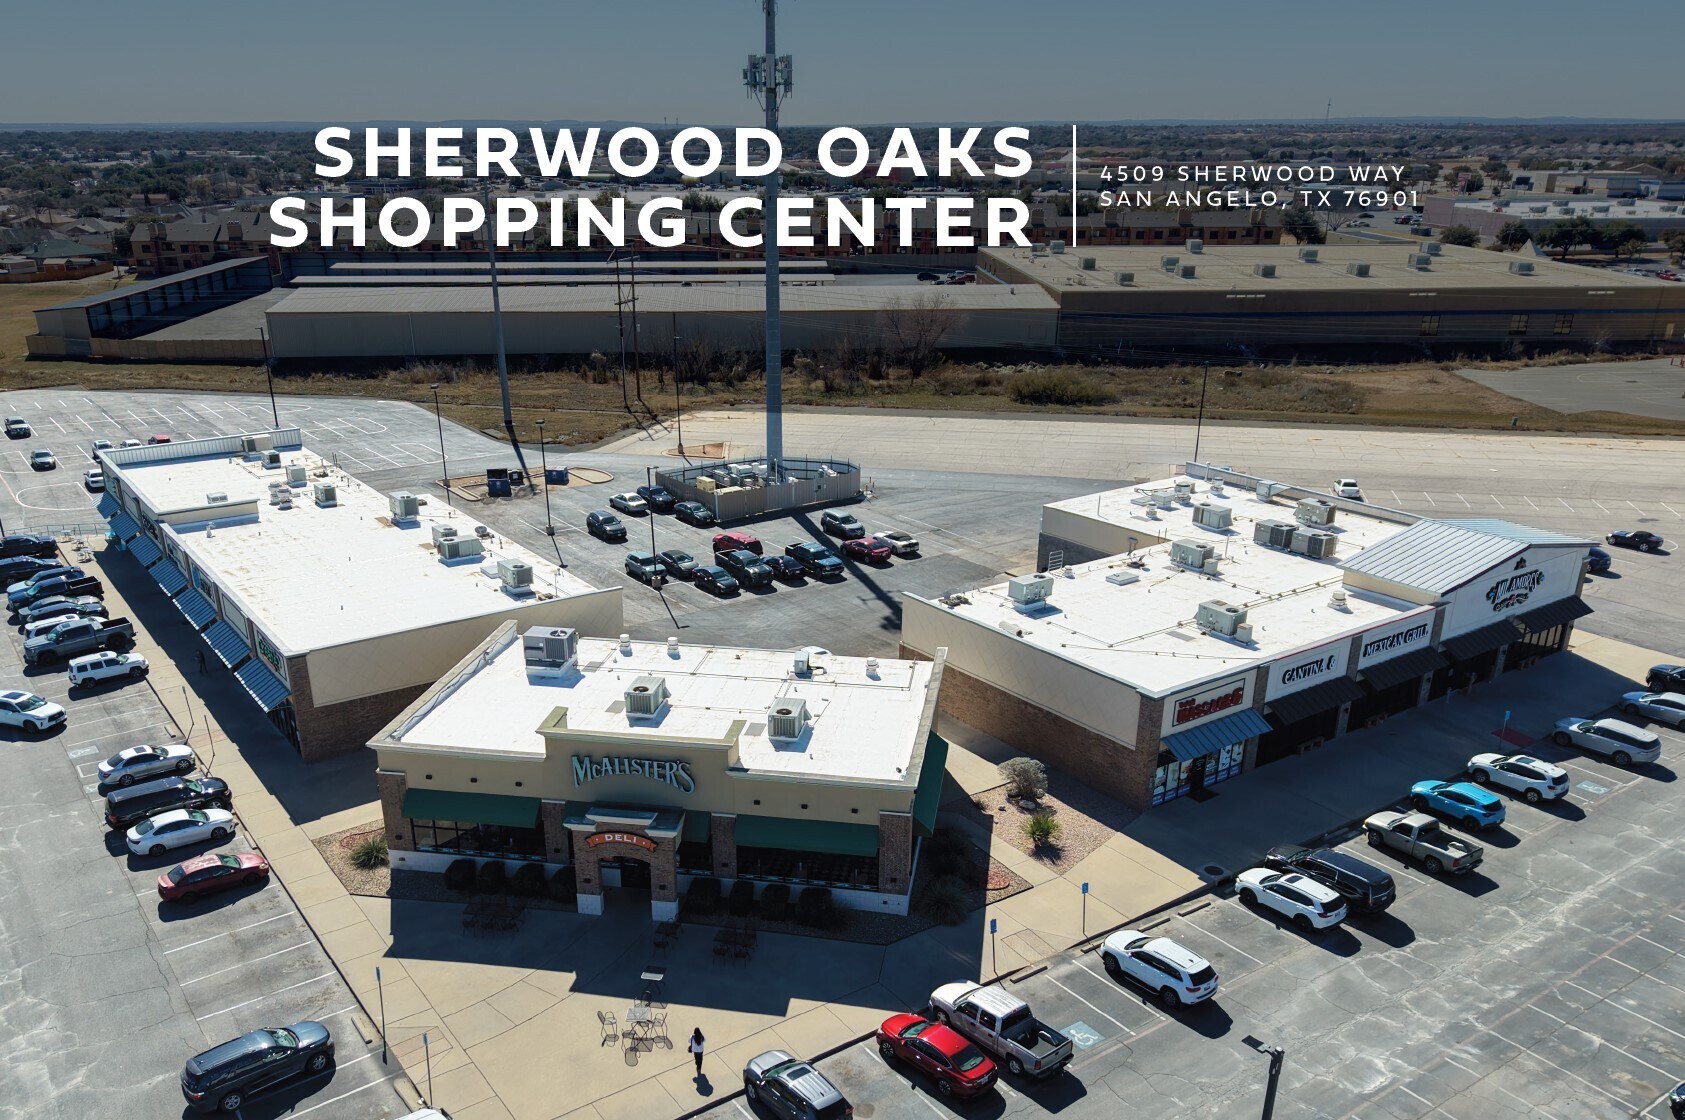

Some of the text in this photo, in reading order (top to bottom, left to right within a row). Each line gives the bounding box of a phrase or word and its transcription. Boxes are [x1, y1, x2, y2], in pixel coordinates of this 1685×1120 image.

[1363, 623, 1429, 657] MEXICAN GRILL
[1282, 655, 1336, 684] CANTINA &
[571, 755, 695, 796] McALISTER'S
[604, 834, 637, 843] DELI
